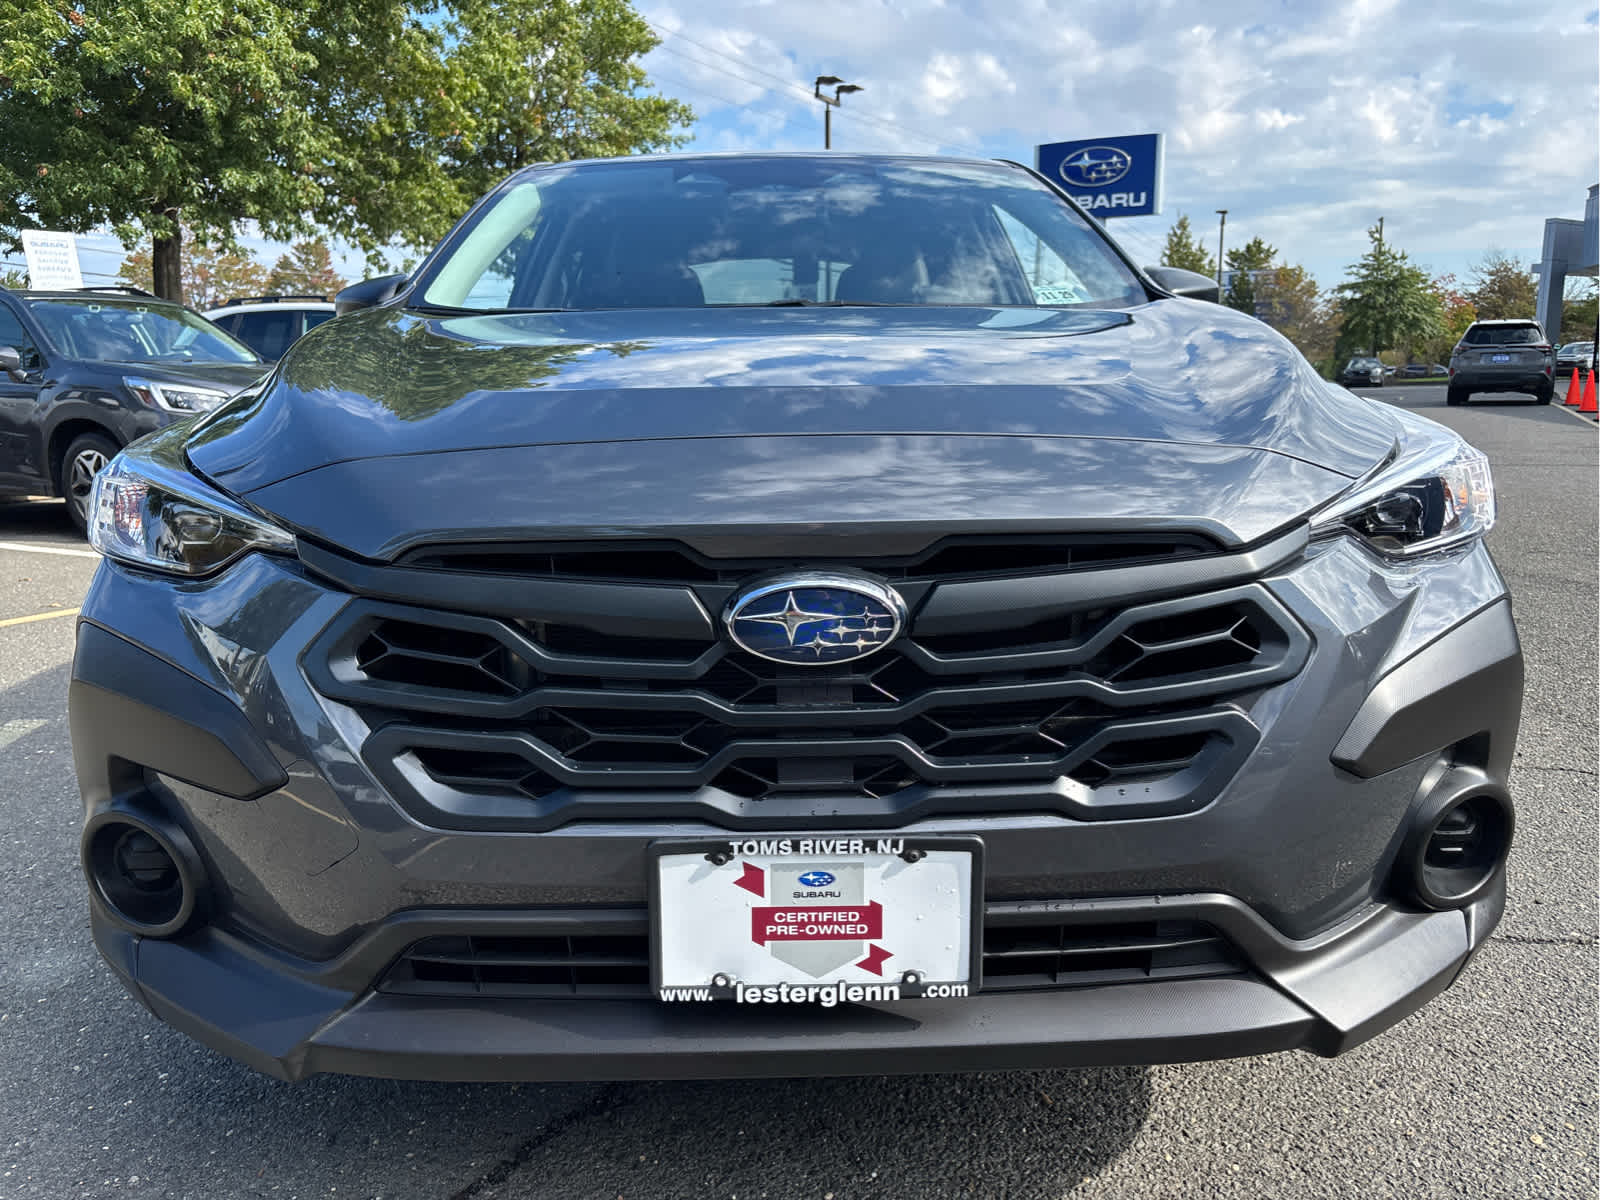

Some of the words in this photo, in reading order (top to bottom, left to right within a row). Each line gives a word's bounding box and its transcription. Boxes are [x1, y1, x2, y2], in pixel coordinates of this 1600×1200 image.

[1074, 192, 1147, 210] BARU
[729, 840, 793, 857] TOMS
[799, 839, 870, 856] RIVER,
[877, 838, 904, 855] NJ
[774, 911, 860, 923] CERTIFIED
[766, 923, 869, 936] PRE-OWNED
[660, 988, 713, 1002] www.
[736, 982, 900, 1007] lesterglenn
[921, 983, 968, 998] .com
